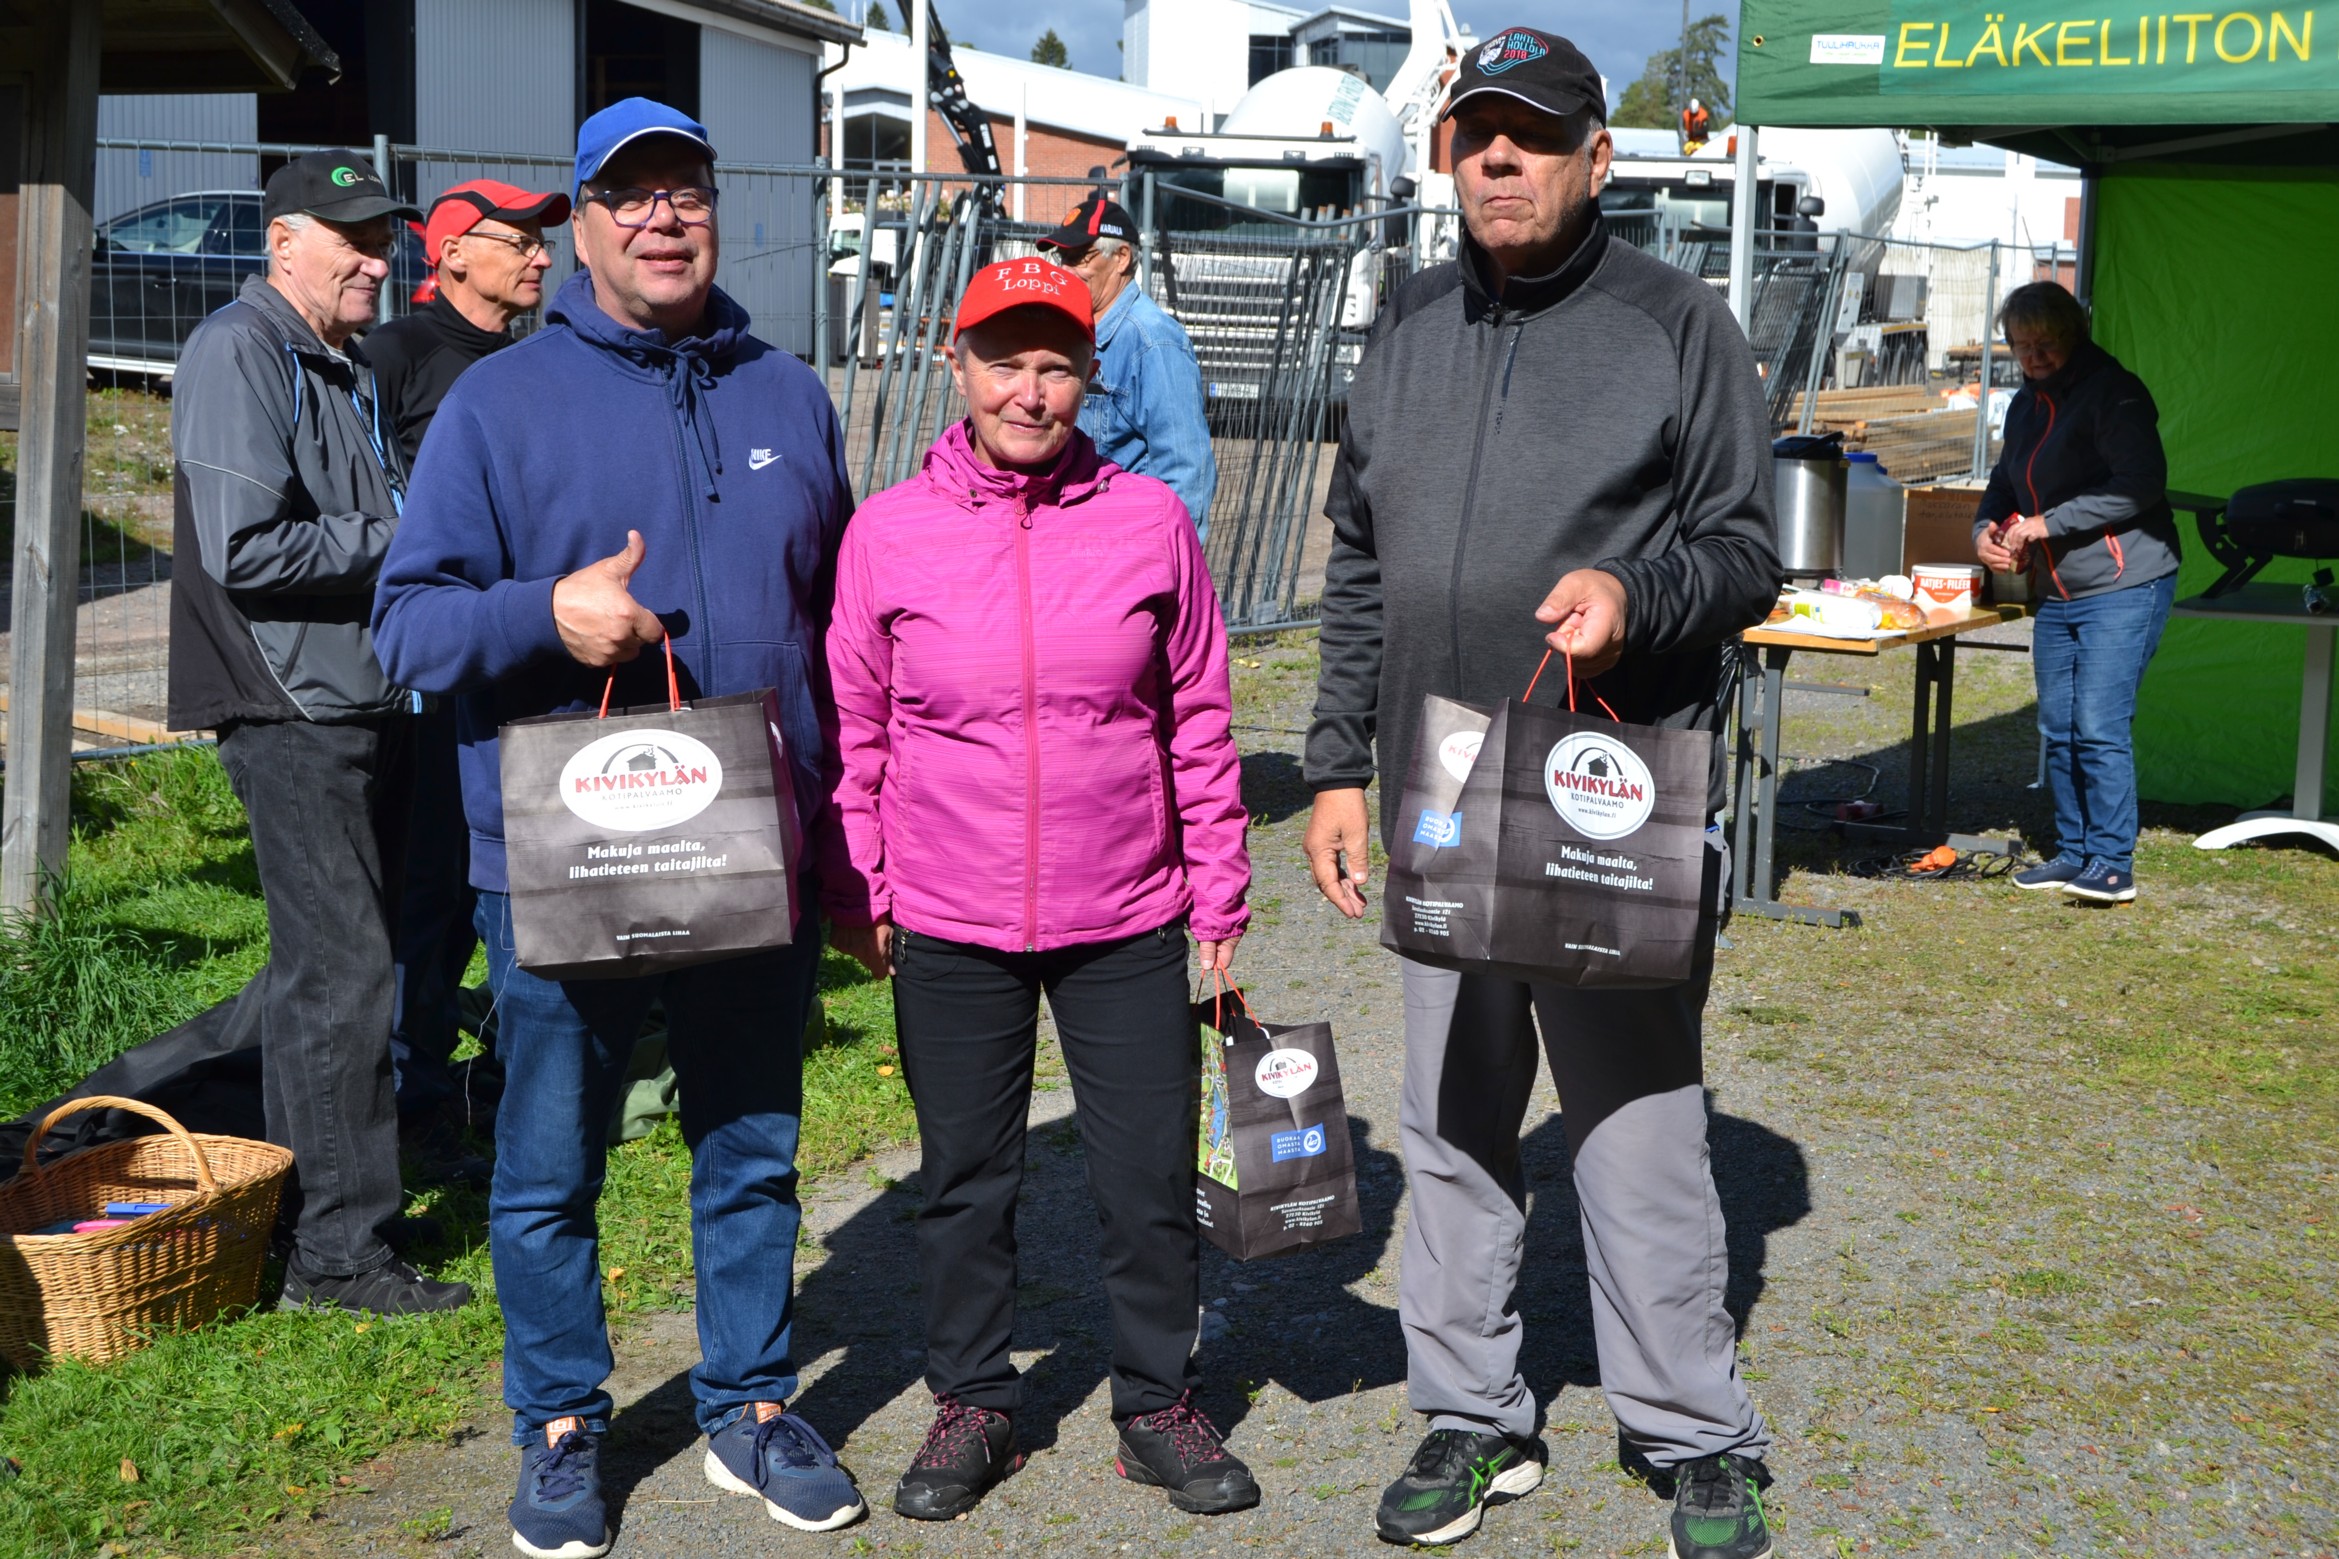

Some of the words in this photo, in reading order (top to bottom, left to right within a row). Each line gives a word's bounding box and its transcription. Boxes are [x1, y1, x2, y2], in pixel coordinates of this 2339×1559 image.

[1508, 32, 1538, 45] LAHTI-
[1894, 9, 2313, 69] ELÄKELIITON
[1503, 49, 1528, 60] 2018
[1507, 40, 1546, 56] HOLLOLA
[1100, 223, 1123, 236] KARJALA
[1003, 278, 1061, 296] Loppi
[750, 448, 772, 461] NIKE
[575, 764, 707, 793] KIVIKYLÄN
[1554, 769, 1643, 802] KIVIKYLÄN
[602, 788, 683, 801] KOTIPALVAAMO
[1571, 792, 1624, 809] KOTIPALVAAMO
[587, 843, 642, 859] Makuja
[647, 840, 705, 855] maalta,
[1561, 845, 1595, 865] Makuja
[1597, 856, 1637, 871] maalta,
[569, 863, 648, 879] lihatieteen
[654, 854, 727, 872] taitajilta!
[1545, 862, 1599, 883] lihatieteen
[1601, 873, 1653, 890] taitajilta!
[631, 930, 671, 939] SUOMALAISTA
[1261, 1062, 1312, 1082] KIVIKYLÄN
